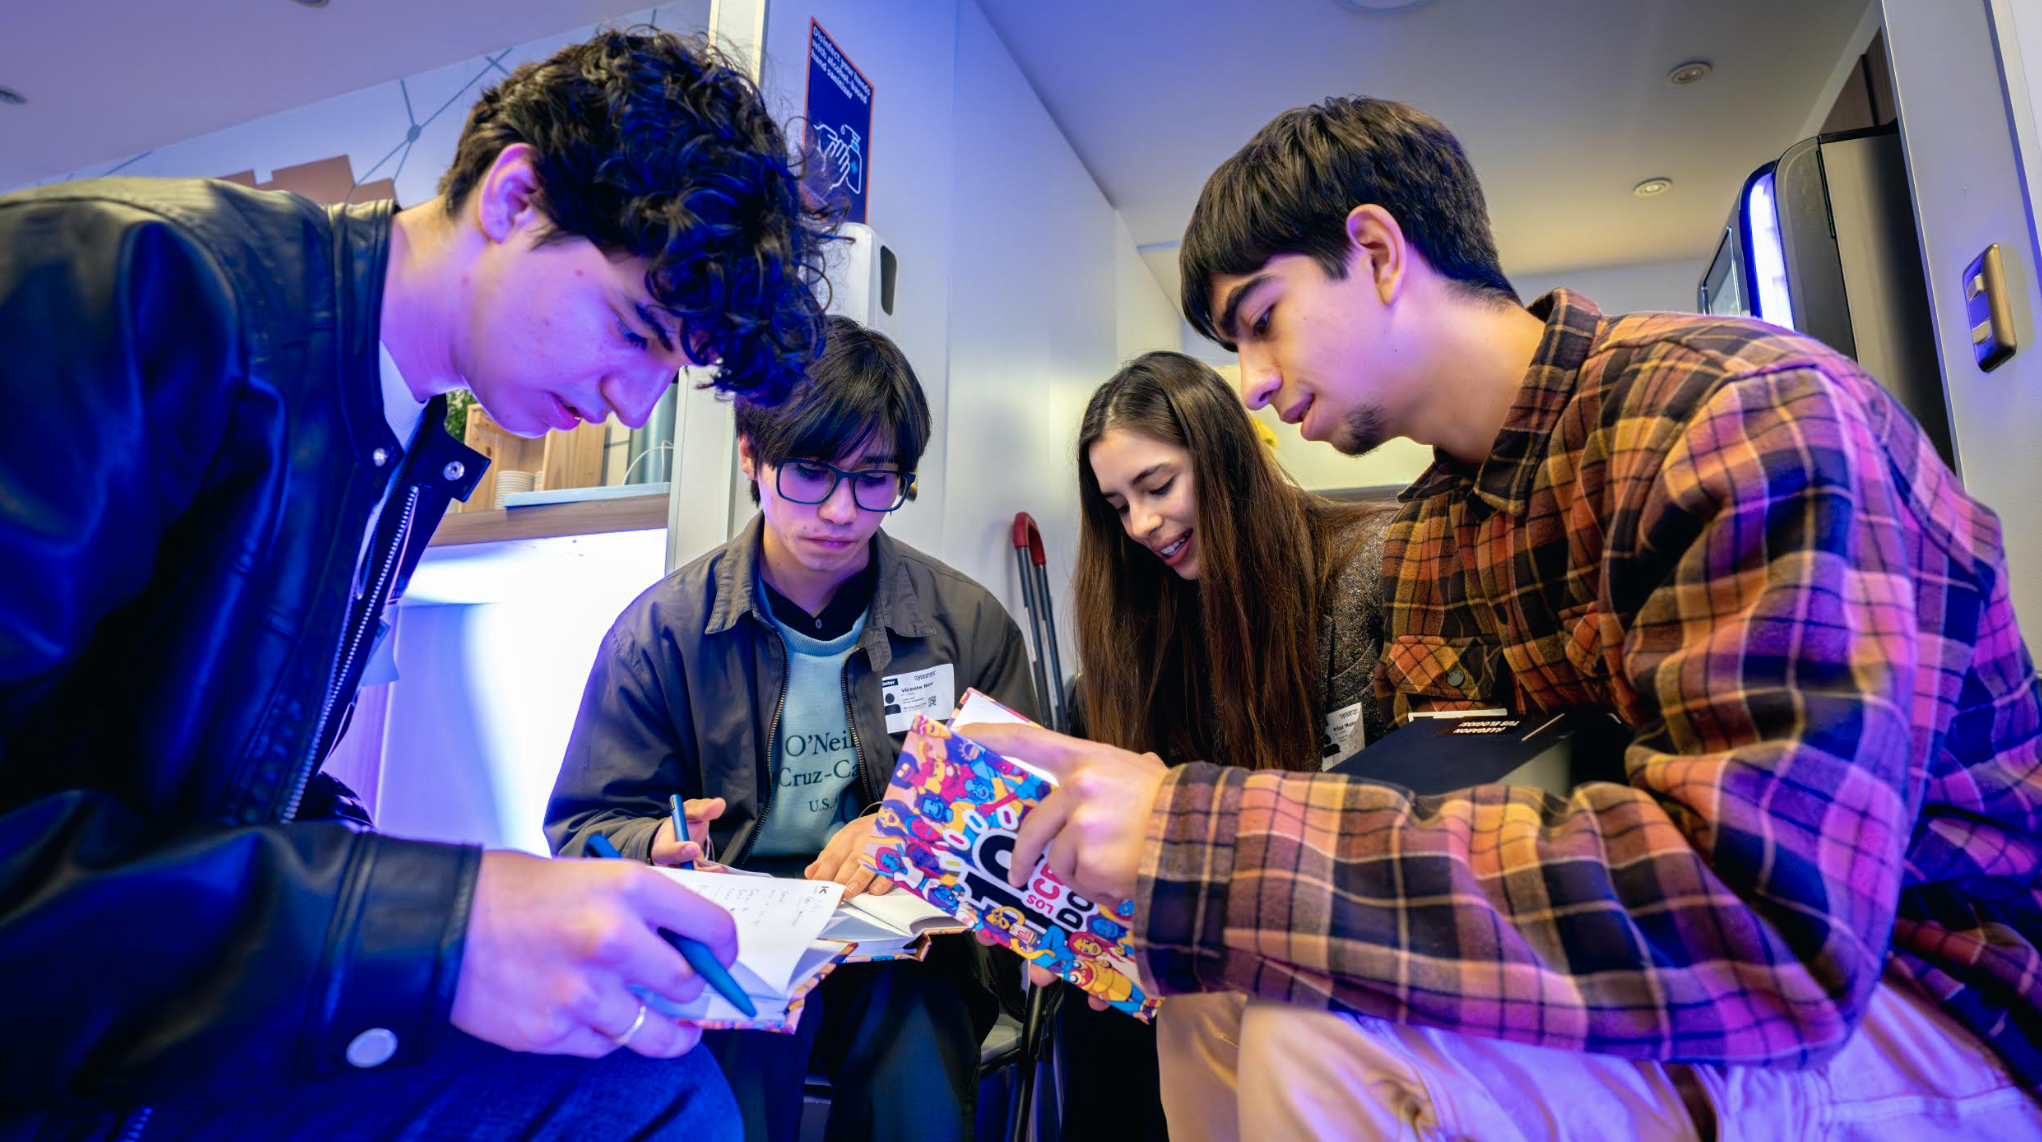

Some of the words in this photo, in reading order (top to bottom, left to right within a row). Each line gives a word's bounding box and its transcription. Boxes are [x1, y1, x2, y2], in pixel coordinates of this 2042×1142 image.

[811, 48, 827, 72] hand
[827, 68, 852, 99] sanitizer
[812, 38, 827, 60] with
[827, 56, 867, 104] alcohol-based
[813, 25, 840, 62] Disinfect
[841, 58, 854, 77] your
[854, 72, 870, 96] hands
[1025, 893, 1054, 914] LOS
